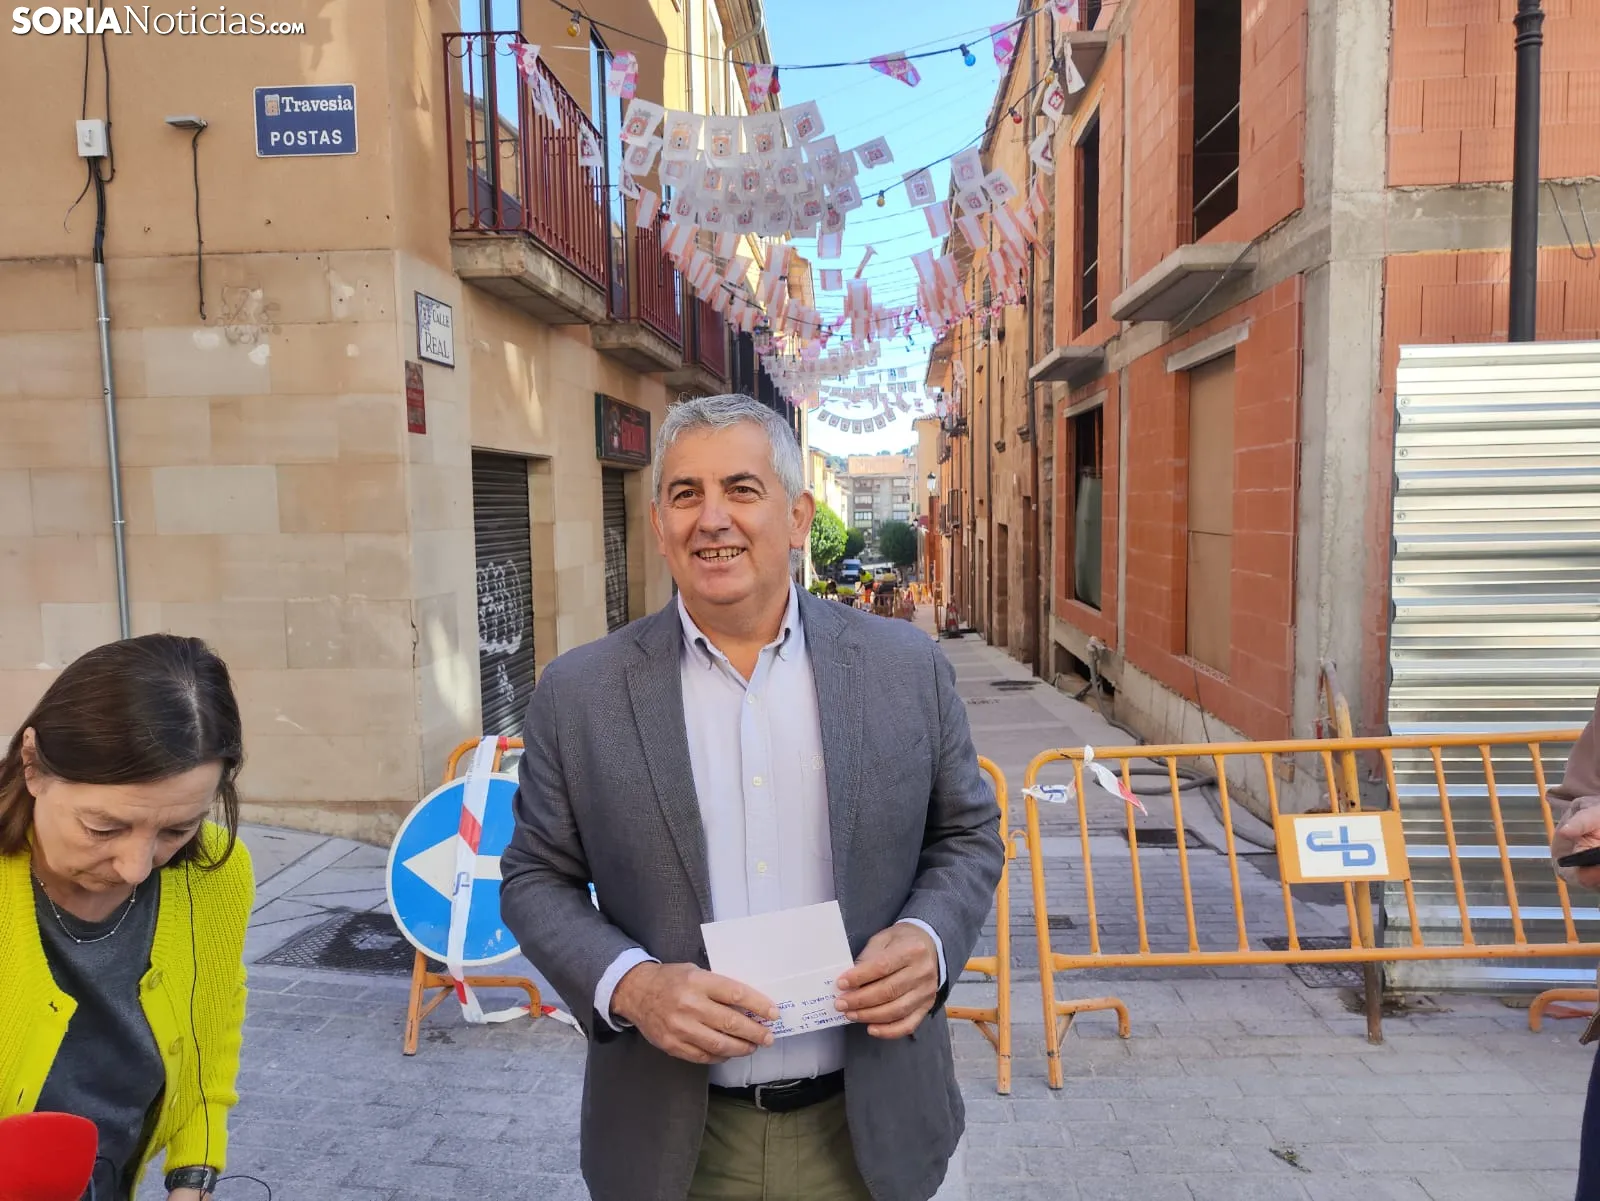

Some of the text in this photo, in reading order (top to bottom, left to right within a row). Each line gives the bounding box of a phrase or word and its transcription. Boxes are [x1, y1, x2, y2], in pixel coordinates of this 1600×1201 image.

[281, 95, 353, 113] Travesia
[270, 129, 342, 147] POSTAS
[432, 309, 450, 328] CALLE
[424, 331, 450, 359] REAL
